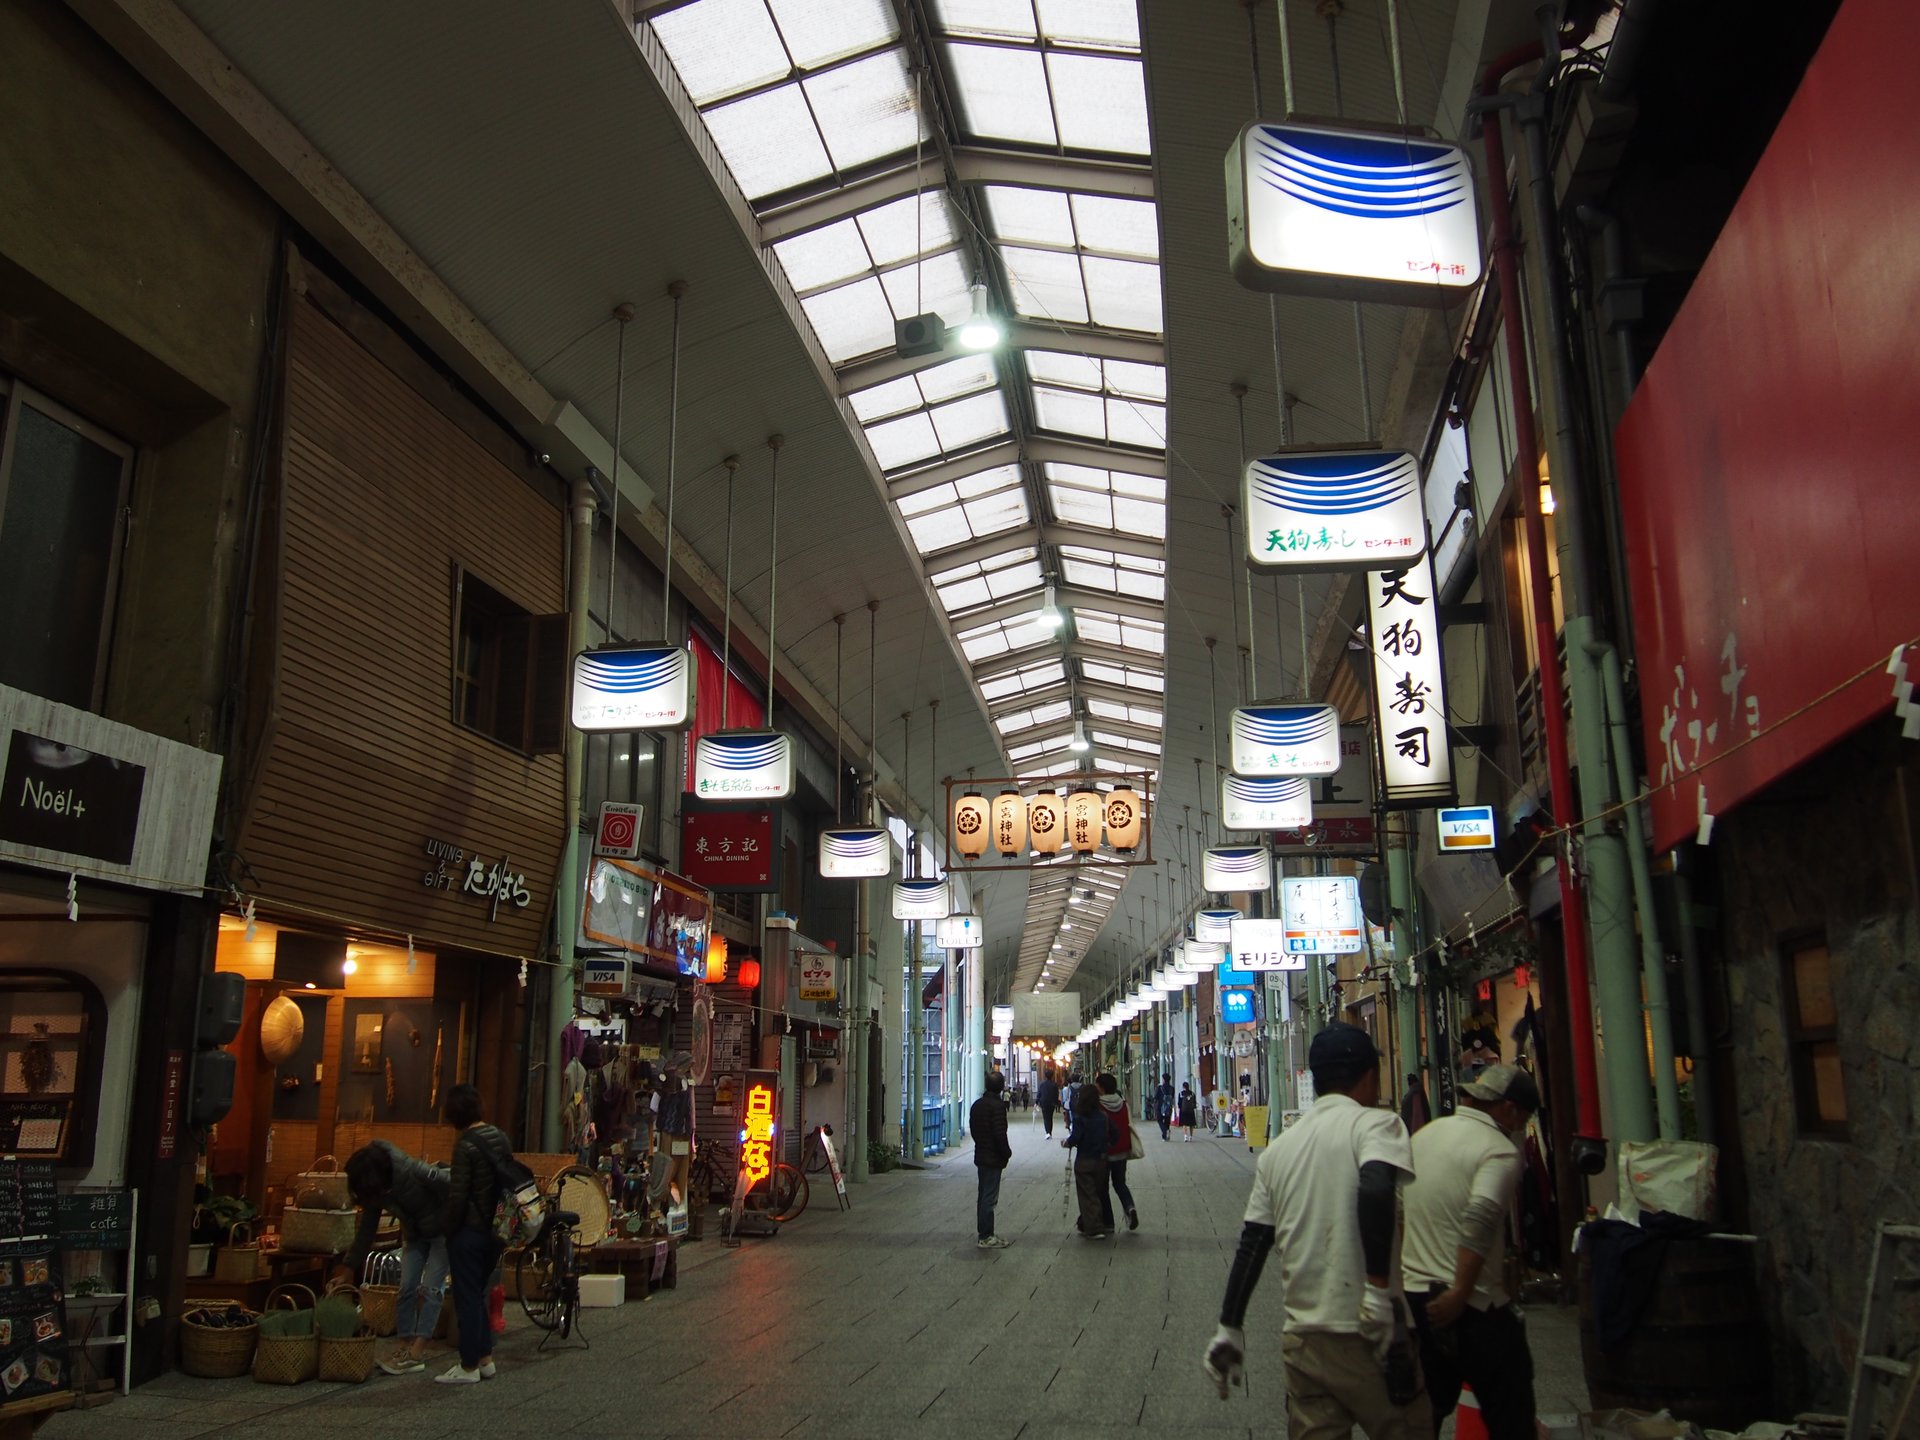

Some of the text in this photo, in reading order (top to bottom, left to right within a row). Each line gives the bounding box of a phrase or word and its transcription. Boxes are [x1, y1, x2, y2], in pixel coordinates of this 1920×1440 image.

[1407, 260, 1466, 276] センター街
[1364, 537, 1412, 548] センター街
[1378, 568, 1431, 768] 天狗寿司
[645, 710, 677, 718] センター街
[20, 776, 86, 819] Noël+
[999, 798, 1013, 846] 一宮神社
[1075, 797, 1089, 844] 一宮神社
[1453, 823, 1481, 833] VISA
[427, 839, 464, 864] LIVING
[695, 836, 759, 854] 東方記
[438, 859, 446, 874] &
[424, 872, 455, 891] GIFT
[463, 854, 532, 922] たかはら
[939, 937, 980, 945] TOILET
[1239, 952, 1299, 966] モリシタ
[593, 971, 616, 982] VISA
[803, 969, 832, 979] ゼブラ
[90, 1216, 119, 1229] café
